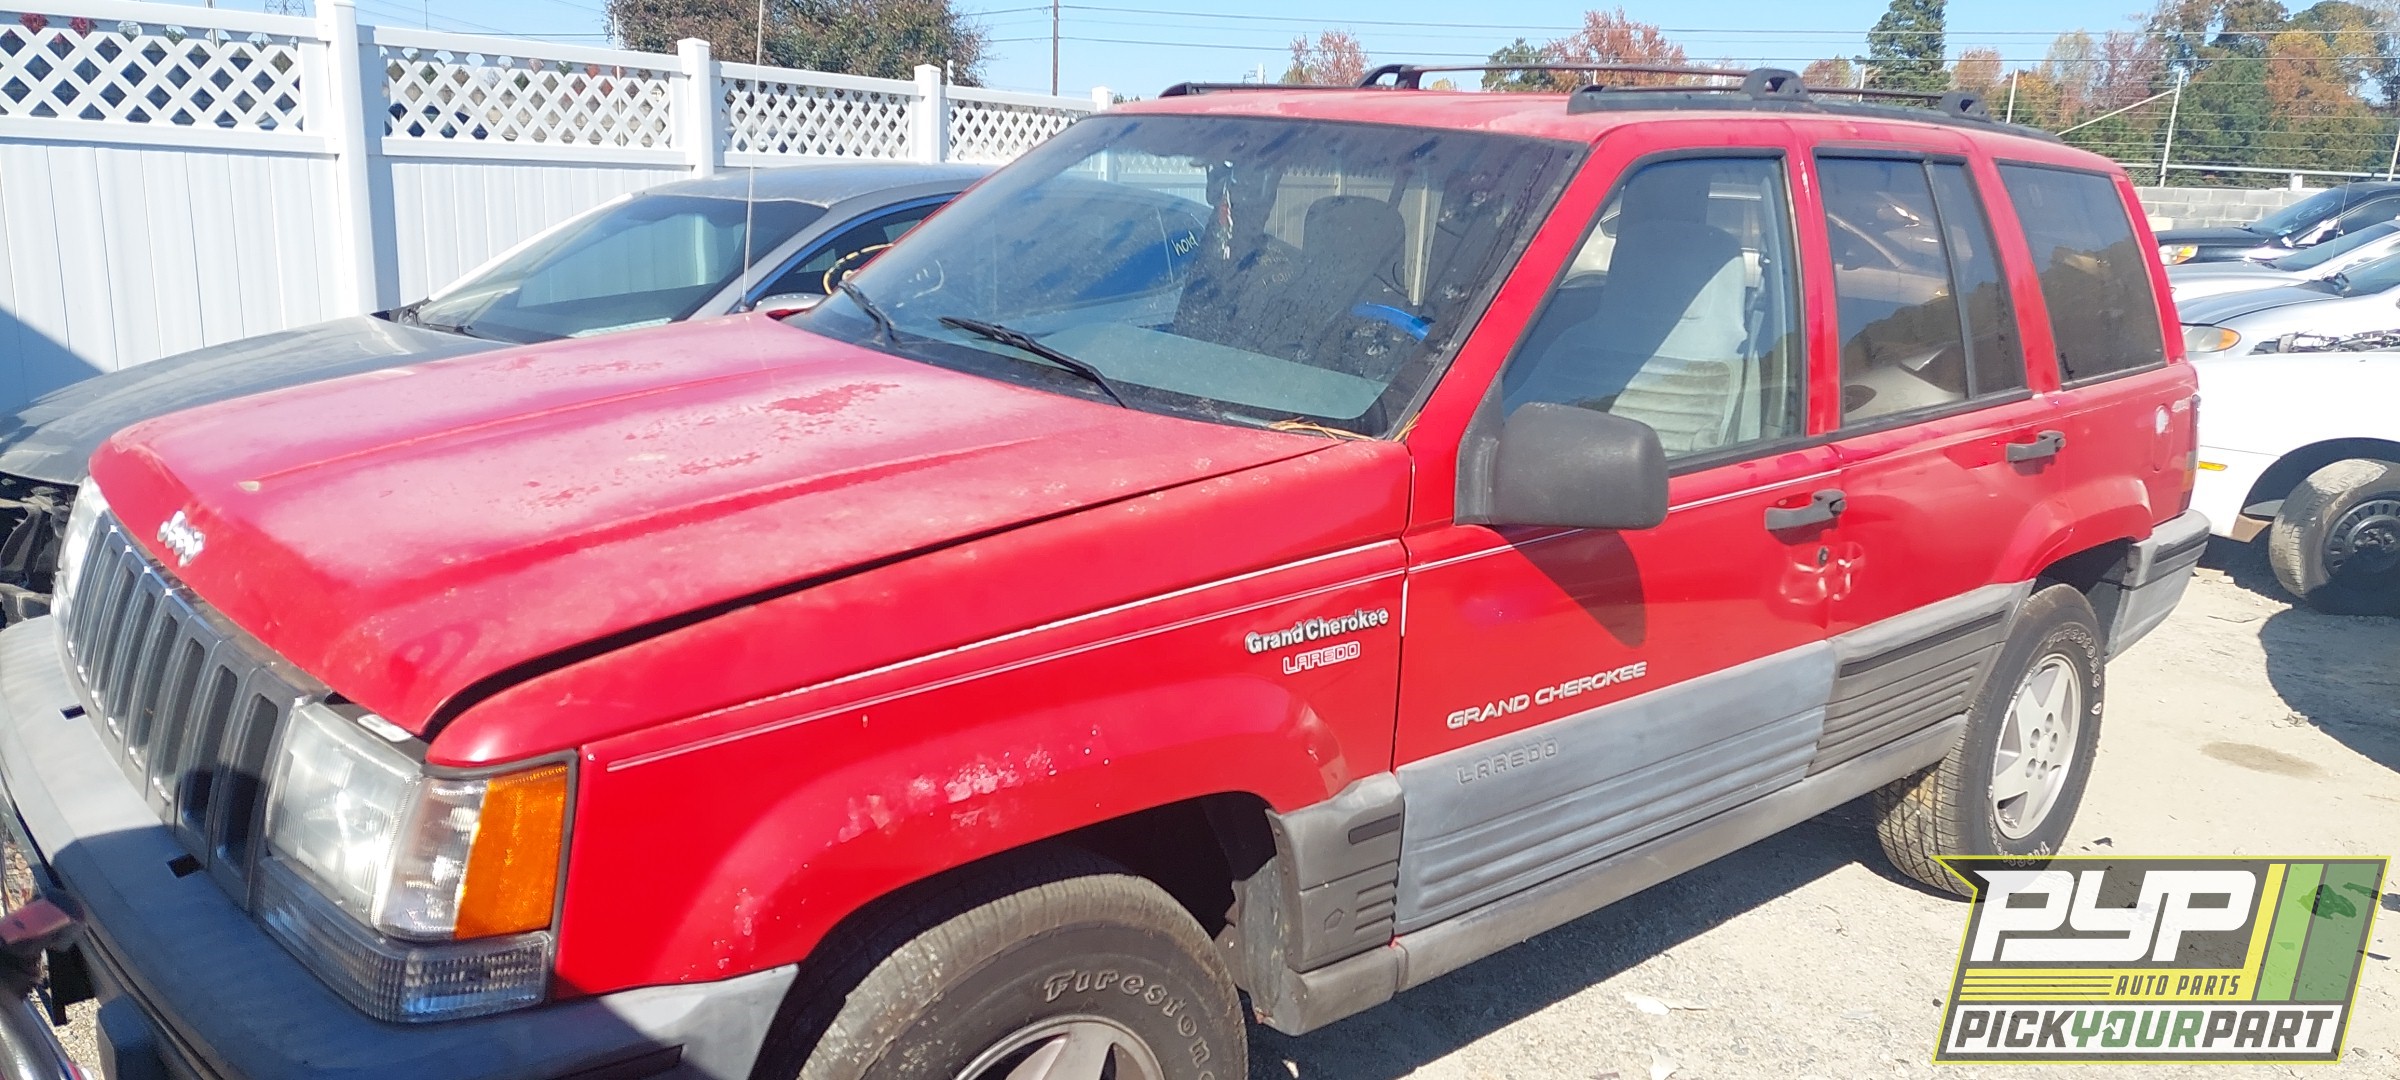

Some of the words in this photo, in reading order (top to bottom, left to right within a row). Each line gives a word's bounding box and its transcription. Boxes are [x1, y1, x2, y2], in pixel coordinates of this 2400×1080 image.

[1282, 640, 1361, 675] LAREDO
[1446, 694, 1530, 729] GRAND
[1534, 661, 1648, 705] CHEROKEE
[1457, 737, 1559, 785] LAREDO
